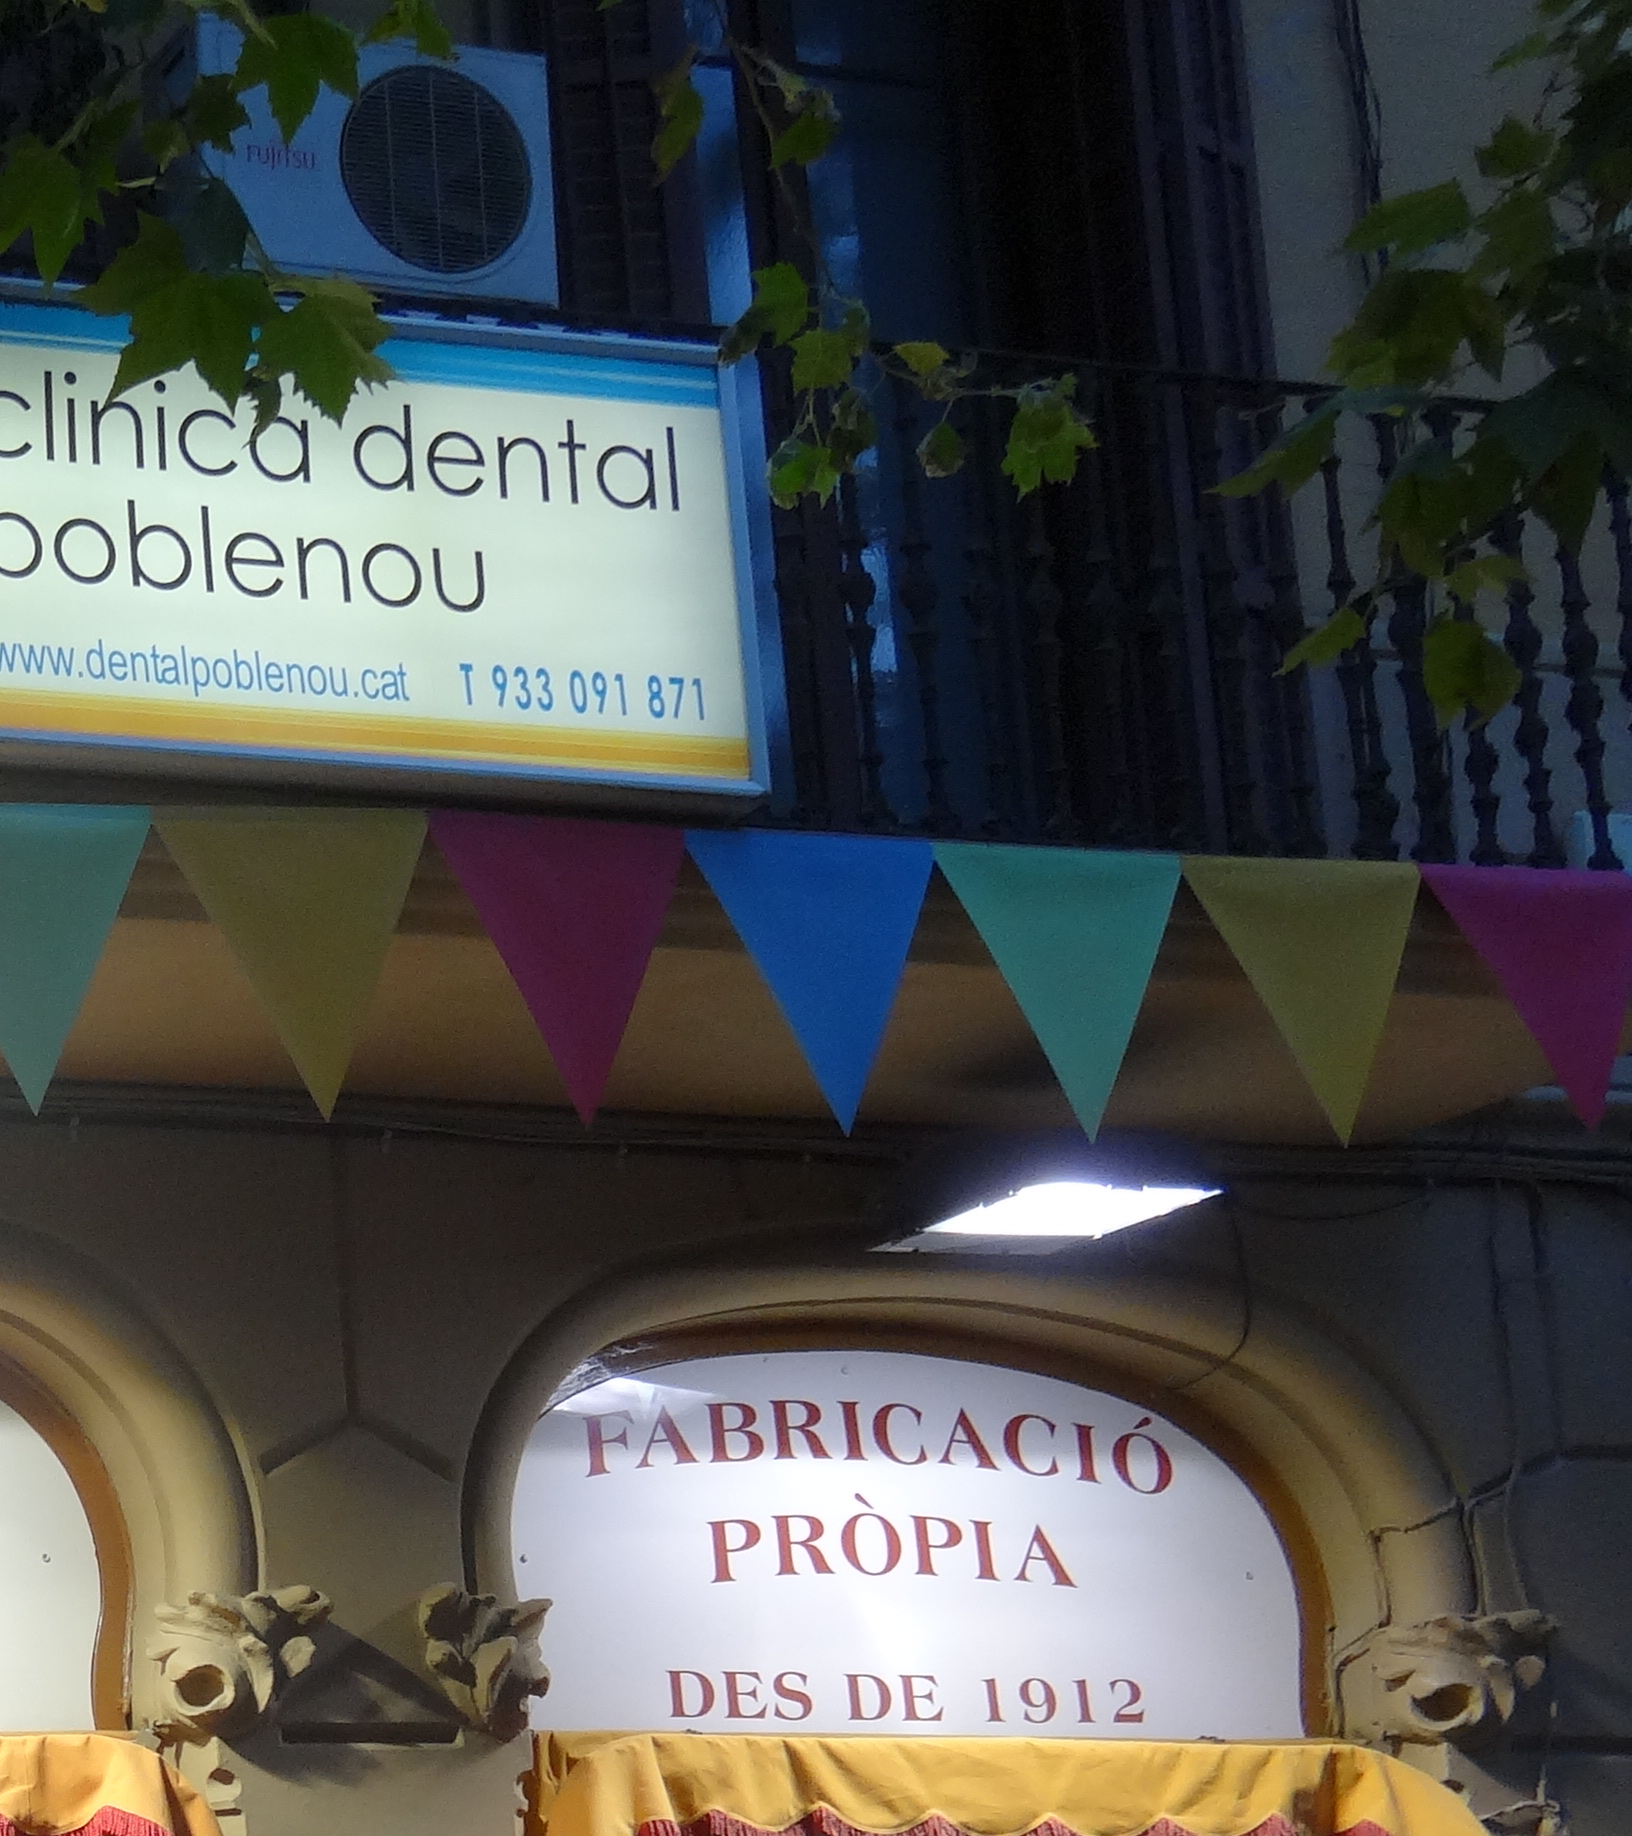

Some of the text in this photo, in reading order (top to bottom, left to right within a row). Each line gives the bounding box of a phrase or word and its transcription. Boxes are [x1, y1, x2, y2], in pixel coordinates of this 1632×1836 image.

[353, 403, 682, 513] dental
[458, 663, 476, 706] T
[491, 664, 554, 715] 933
[569, 668, 630, 719] 091
[647, 672, 707, 722] 871
[582, 1399, 1177, 1496] FABRICACIÓ
[706, 1492, 1079, 1589] PRÒPIA
[666, 1669, 1147, 1726] DES DE 1912
